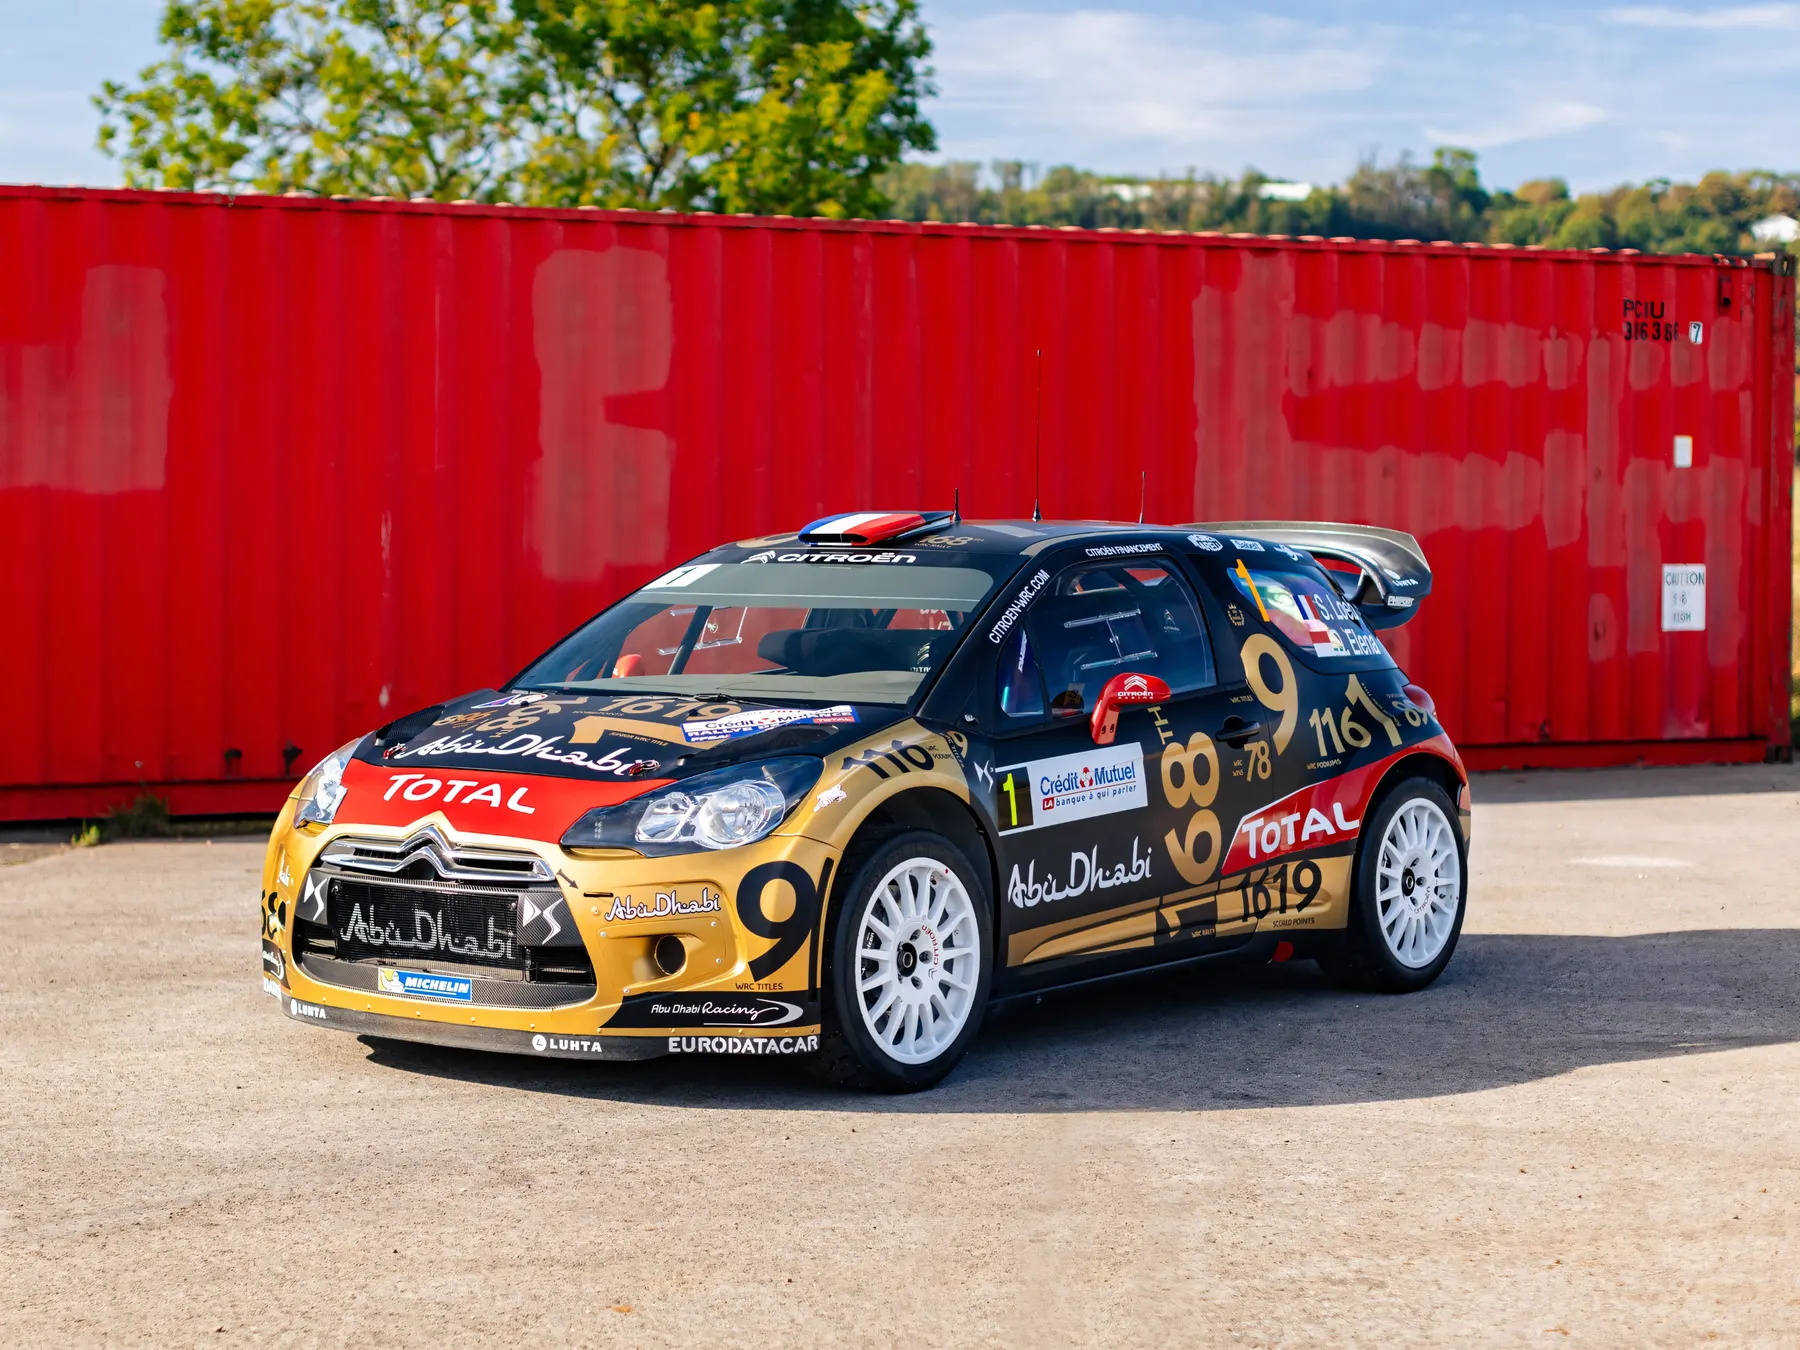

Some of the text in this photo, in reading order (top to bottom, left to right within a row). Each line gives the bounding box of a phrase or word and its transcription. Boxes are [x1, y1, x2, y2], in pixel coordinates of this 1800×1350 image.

[1622, 298, 1665, 319] PCIU
[988, 568, 1051, 645] CITROEN-WRC.COM
[1235, 558, 1270, 622] 1
[1240, 633, 1299, 756] 9
[1040, 761, 1136, 796] Crédit Mutuel
[1244, 740, 1272, 782] 78
[383, 773, 536, 815] TOTAL
[1003, 772, 1018, 826] 1
[1043, 797, 1055, 810] LA
[1055, 794, 1086, 807] banque
[1096, 787, 1110, 799] qui
[1112, 784, 1137, 797] parler
[1241, 801, 1361, 859] TOTAL
[1007, 835, 1153, 909] Abu Dhabi
[605, 886, 722, 921] Abu Dhabi
[736, 860, 819, 983] 9
[340, 902, 402, 947] Abu
[400, 908, 517, 960] Dhabi
[405, 976, 469, 994] MICHELIN
[735, 982, 784, 991] WRC TITLES
[297, 1003, 327, 1020] LUHTA
[651, 1001, 772, 1022] Abu Dhabi Racing
[549, 1038, 603, 1053] LUHTA
[668, 1035, 819, 1054] EURODATACAR
